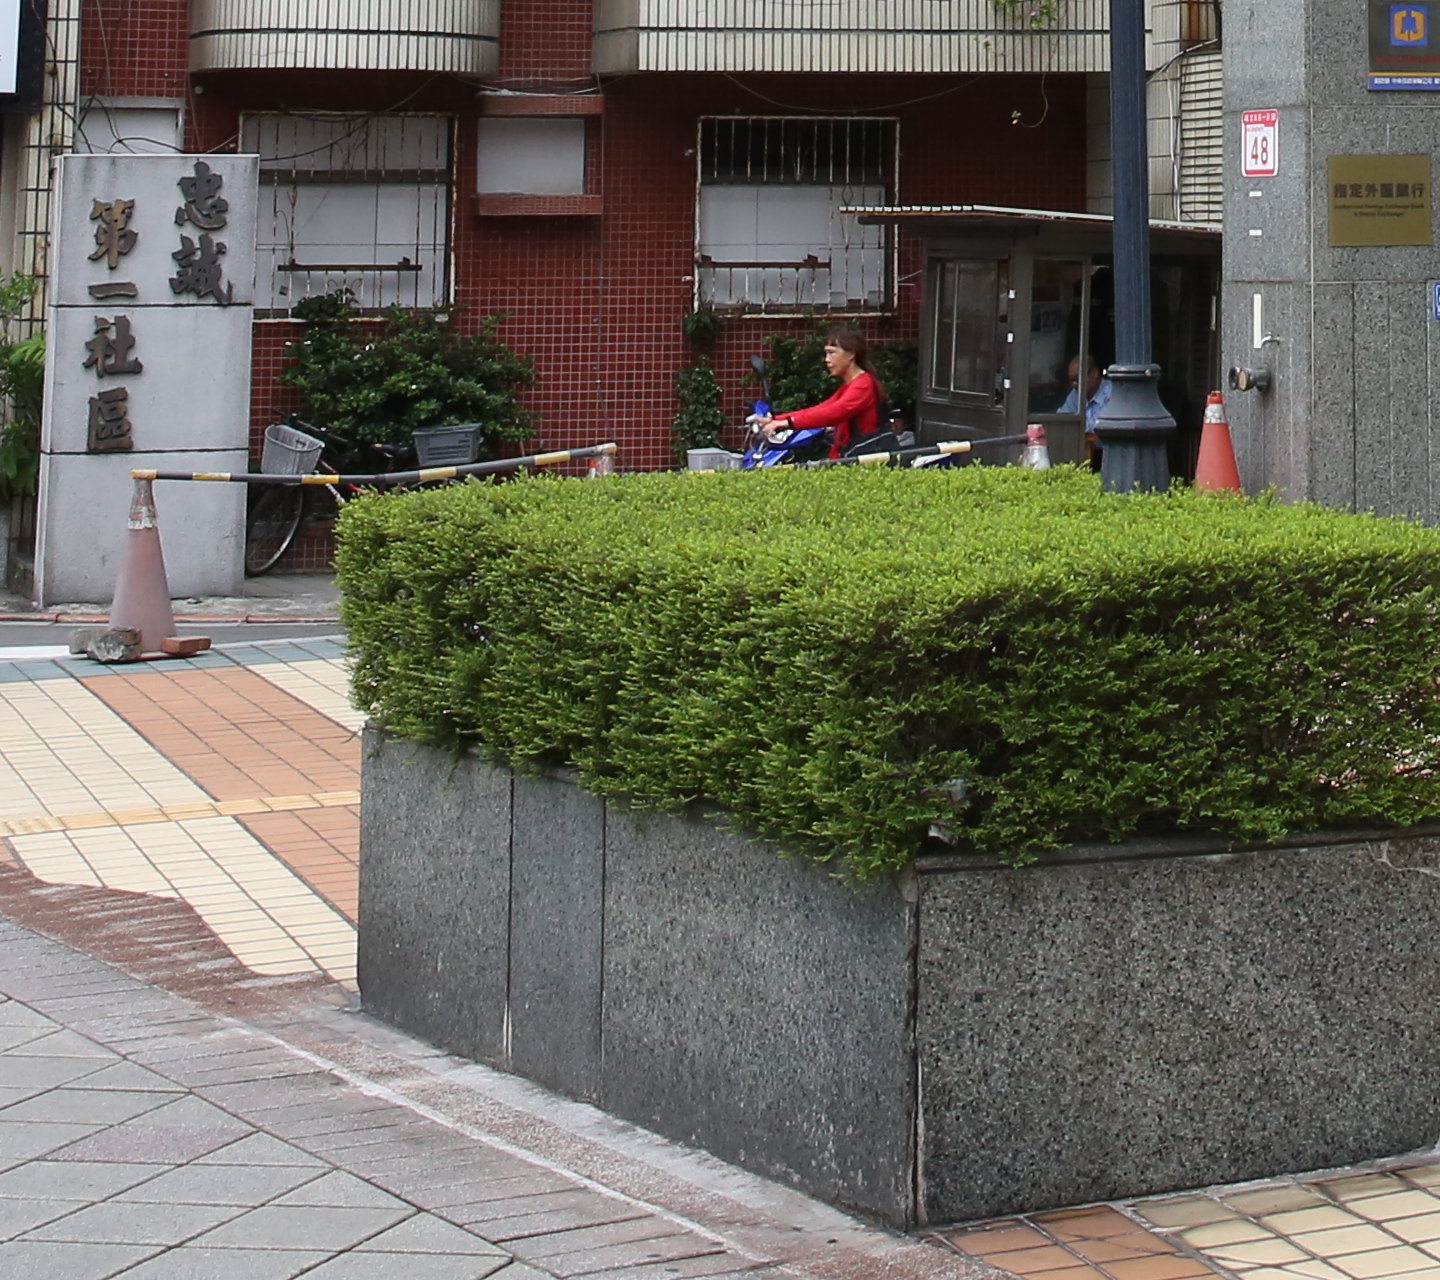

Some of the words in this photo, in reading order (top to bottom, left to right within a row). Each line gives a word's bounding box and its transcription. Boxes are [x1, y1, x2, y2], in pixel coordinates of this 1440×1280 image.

[1251, 136, 1269, 166] 48
[171, 162, 233, 305] 忠誠
[84, 197, 144, 455] 第一社區
